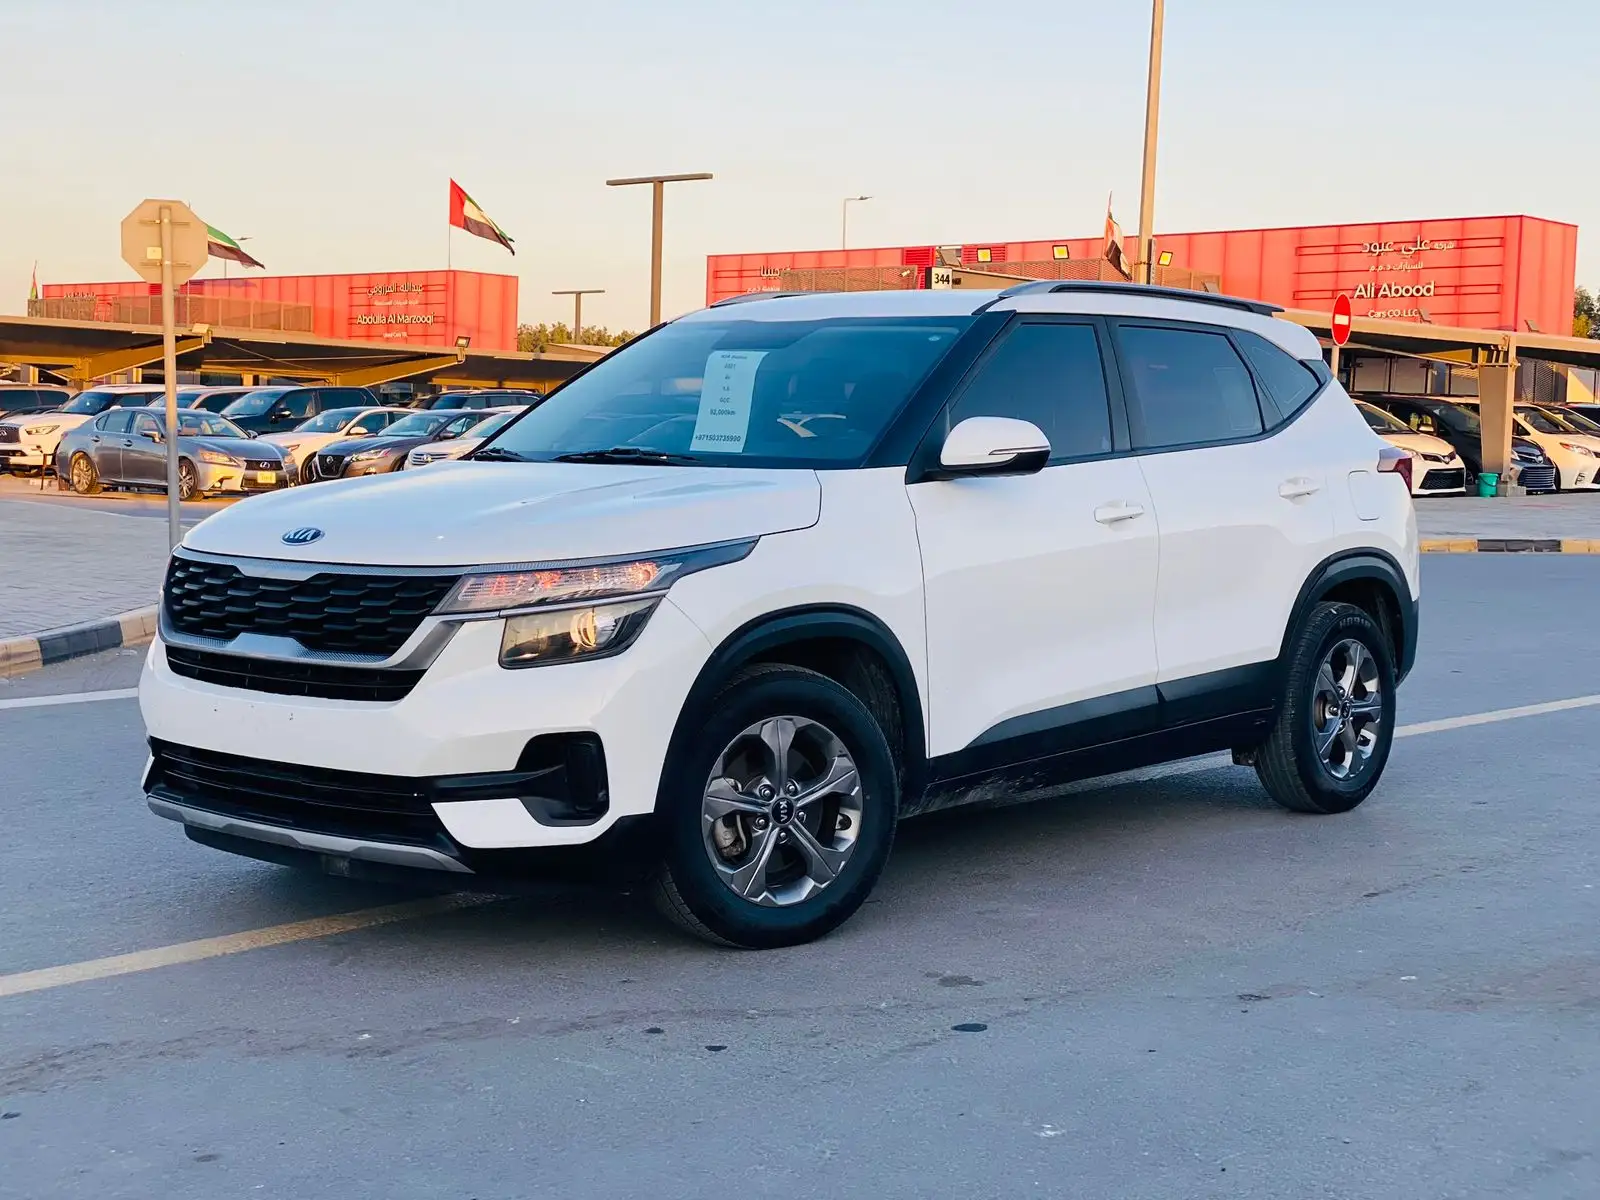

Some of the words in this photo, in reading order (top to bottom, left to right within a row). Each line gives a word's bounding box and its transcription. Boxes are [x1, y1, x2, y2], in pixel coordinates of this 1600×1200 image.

[1361, 240, 1395, 256] عبود
[1401, 234, 1431, 256] علي
[934, 273, 951, 285] 344
[1354, 281, 1376, 299] Ali
[1378, 280, 1436, 298] Abood
[357, 313, 387, 325] Abdulla
[387, 313, 396, 325] Al
[398, 311, 436, 327] Marzooqi
[284, 528, 317, 541] KIA
[780, 800, 788, 822] KIA
